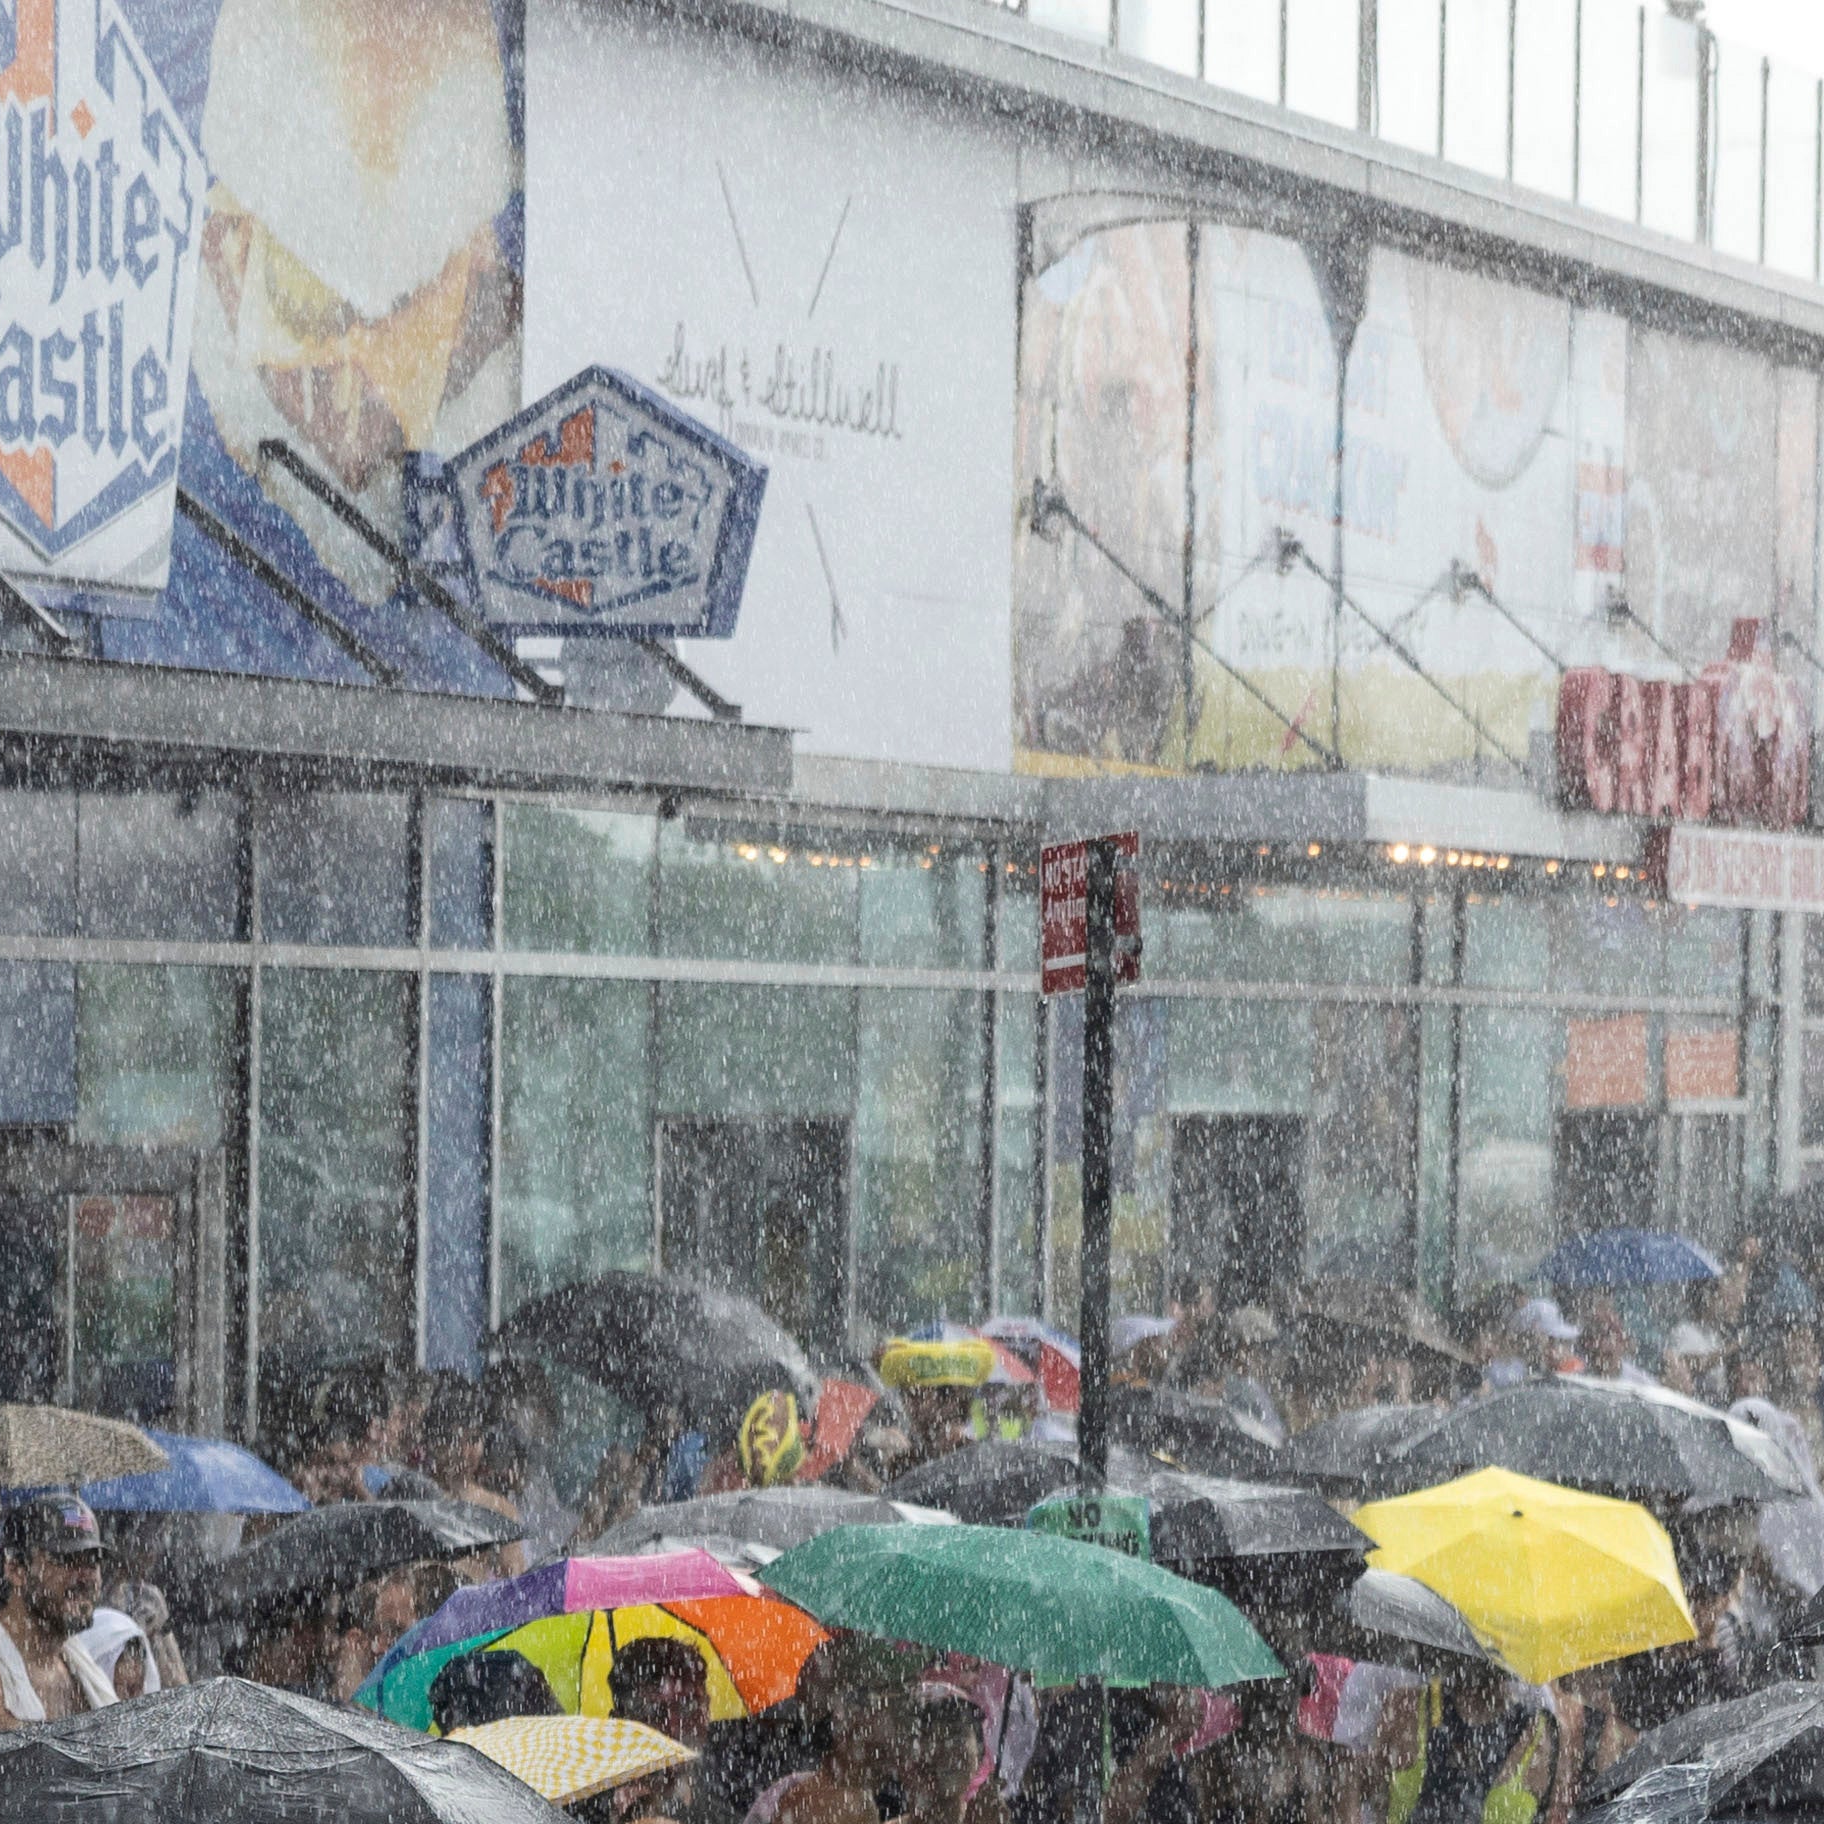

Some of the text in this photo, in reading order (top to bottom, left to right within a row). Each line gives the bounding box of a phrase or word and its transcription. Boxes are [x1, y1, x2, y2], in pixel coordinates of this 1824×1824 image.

[508, 464, 683, 531] White
[494, 523, 695, 578] Castle
[1068, 1502, 1101, 1530] NO
